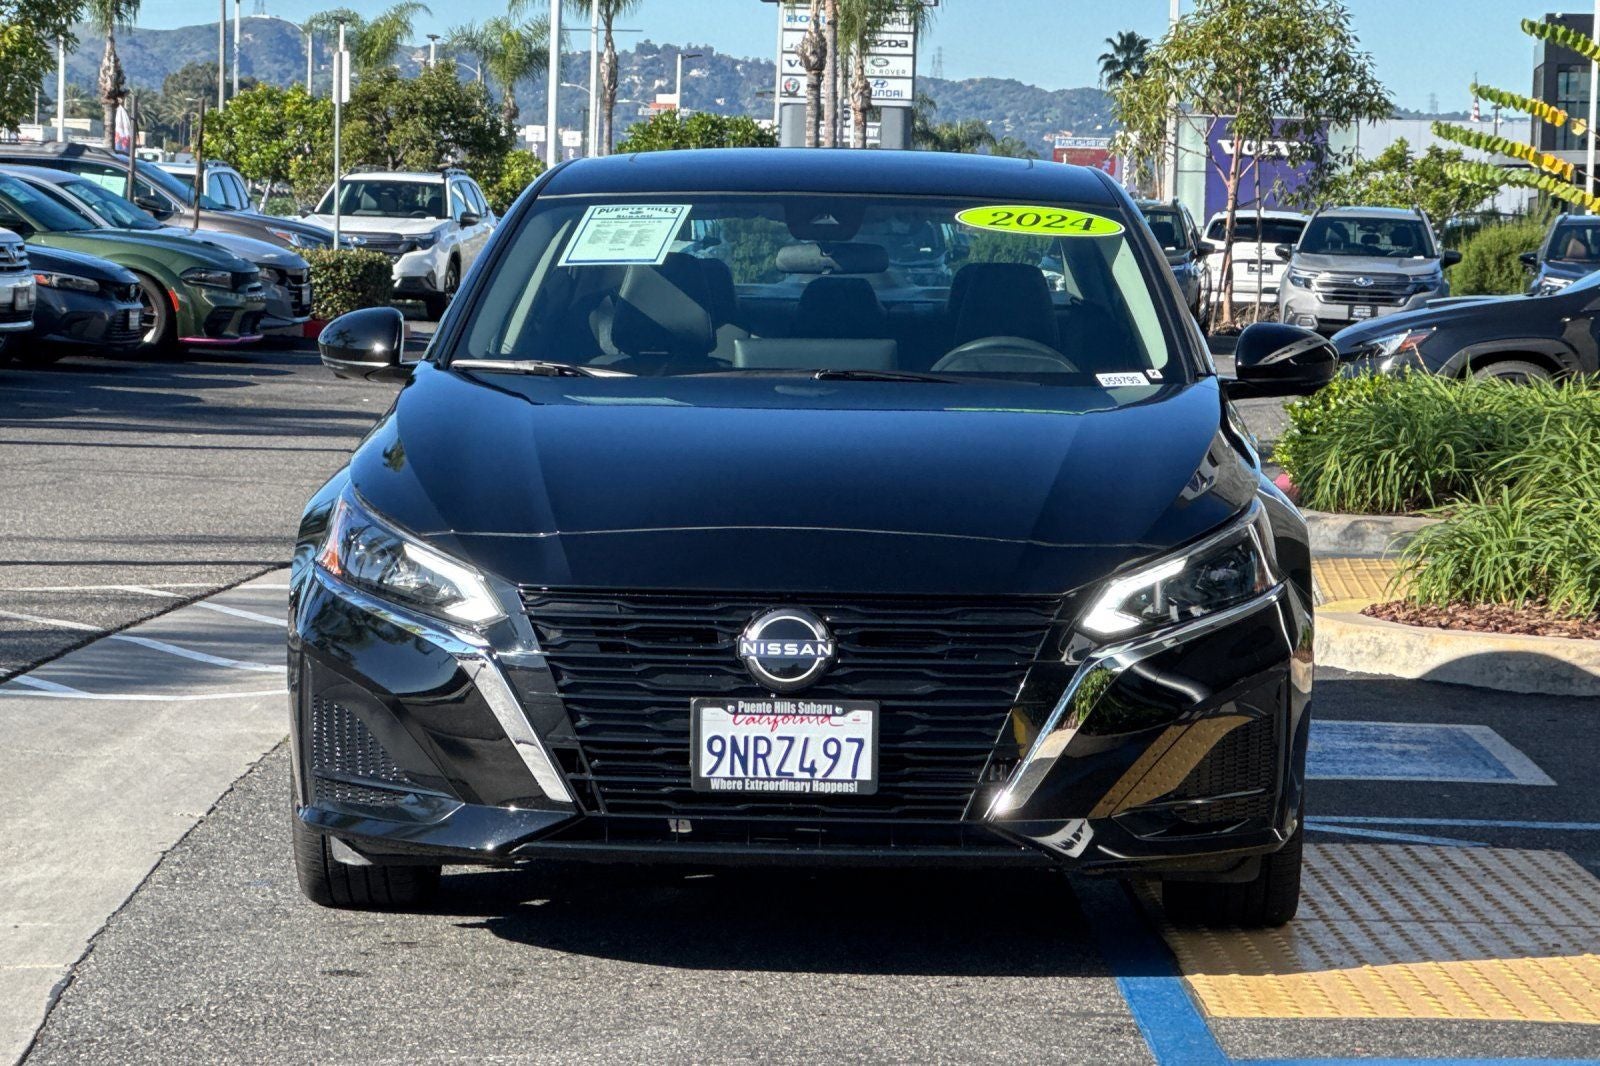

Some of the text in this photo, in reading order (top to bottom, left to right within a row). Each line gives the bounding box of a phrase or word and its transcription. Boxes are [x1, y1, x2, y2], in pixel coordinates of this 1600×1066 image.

[597, 206, 678, 215] PUENTE HILLS
[988, 211, 1096, 231] 2024
[742, 642, 832, 656] NISSAN
[737, 701, 833, 715] Puente Hills Subaru
[732, 713, 844, 733] California
[706, 734, 865, 779] 9NRZ497
[710, 779, 858, 793] Where Extraordinary Happens!
